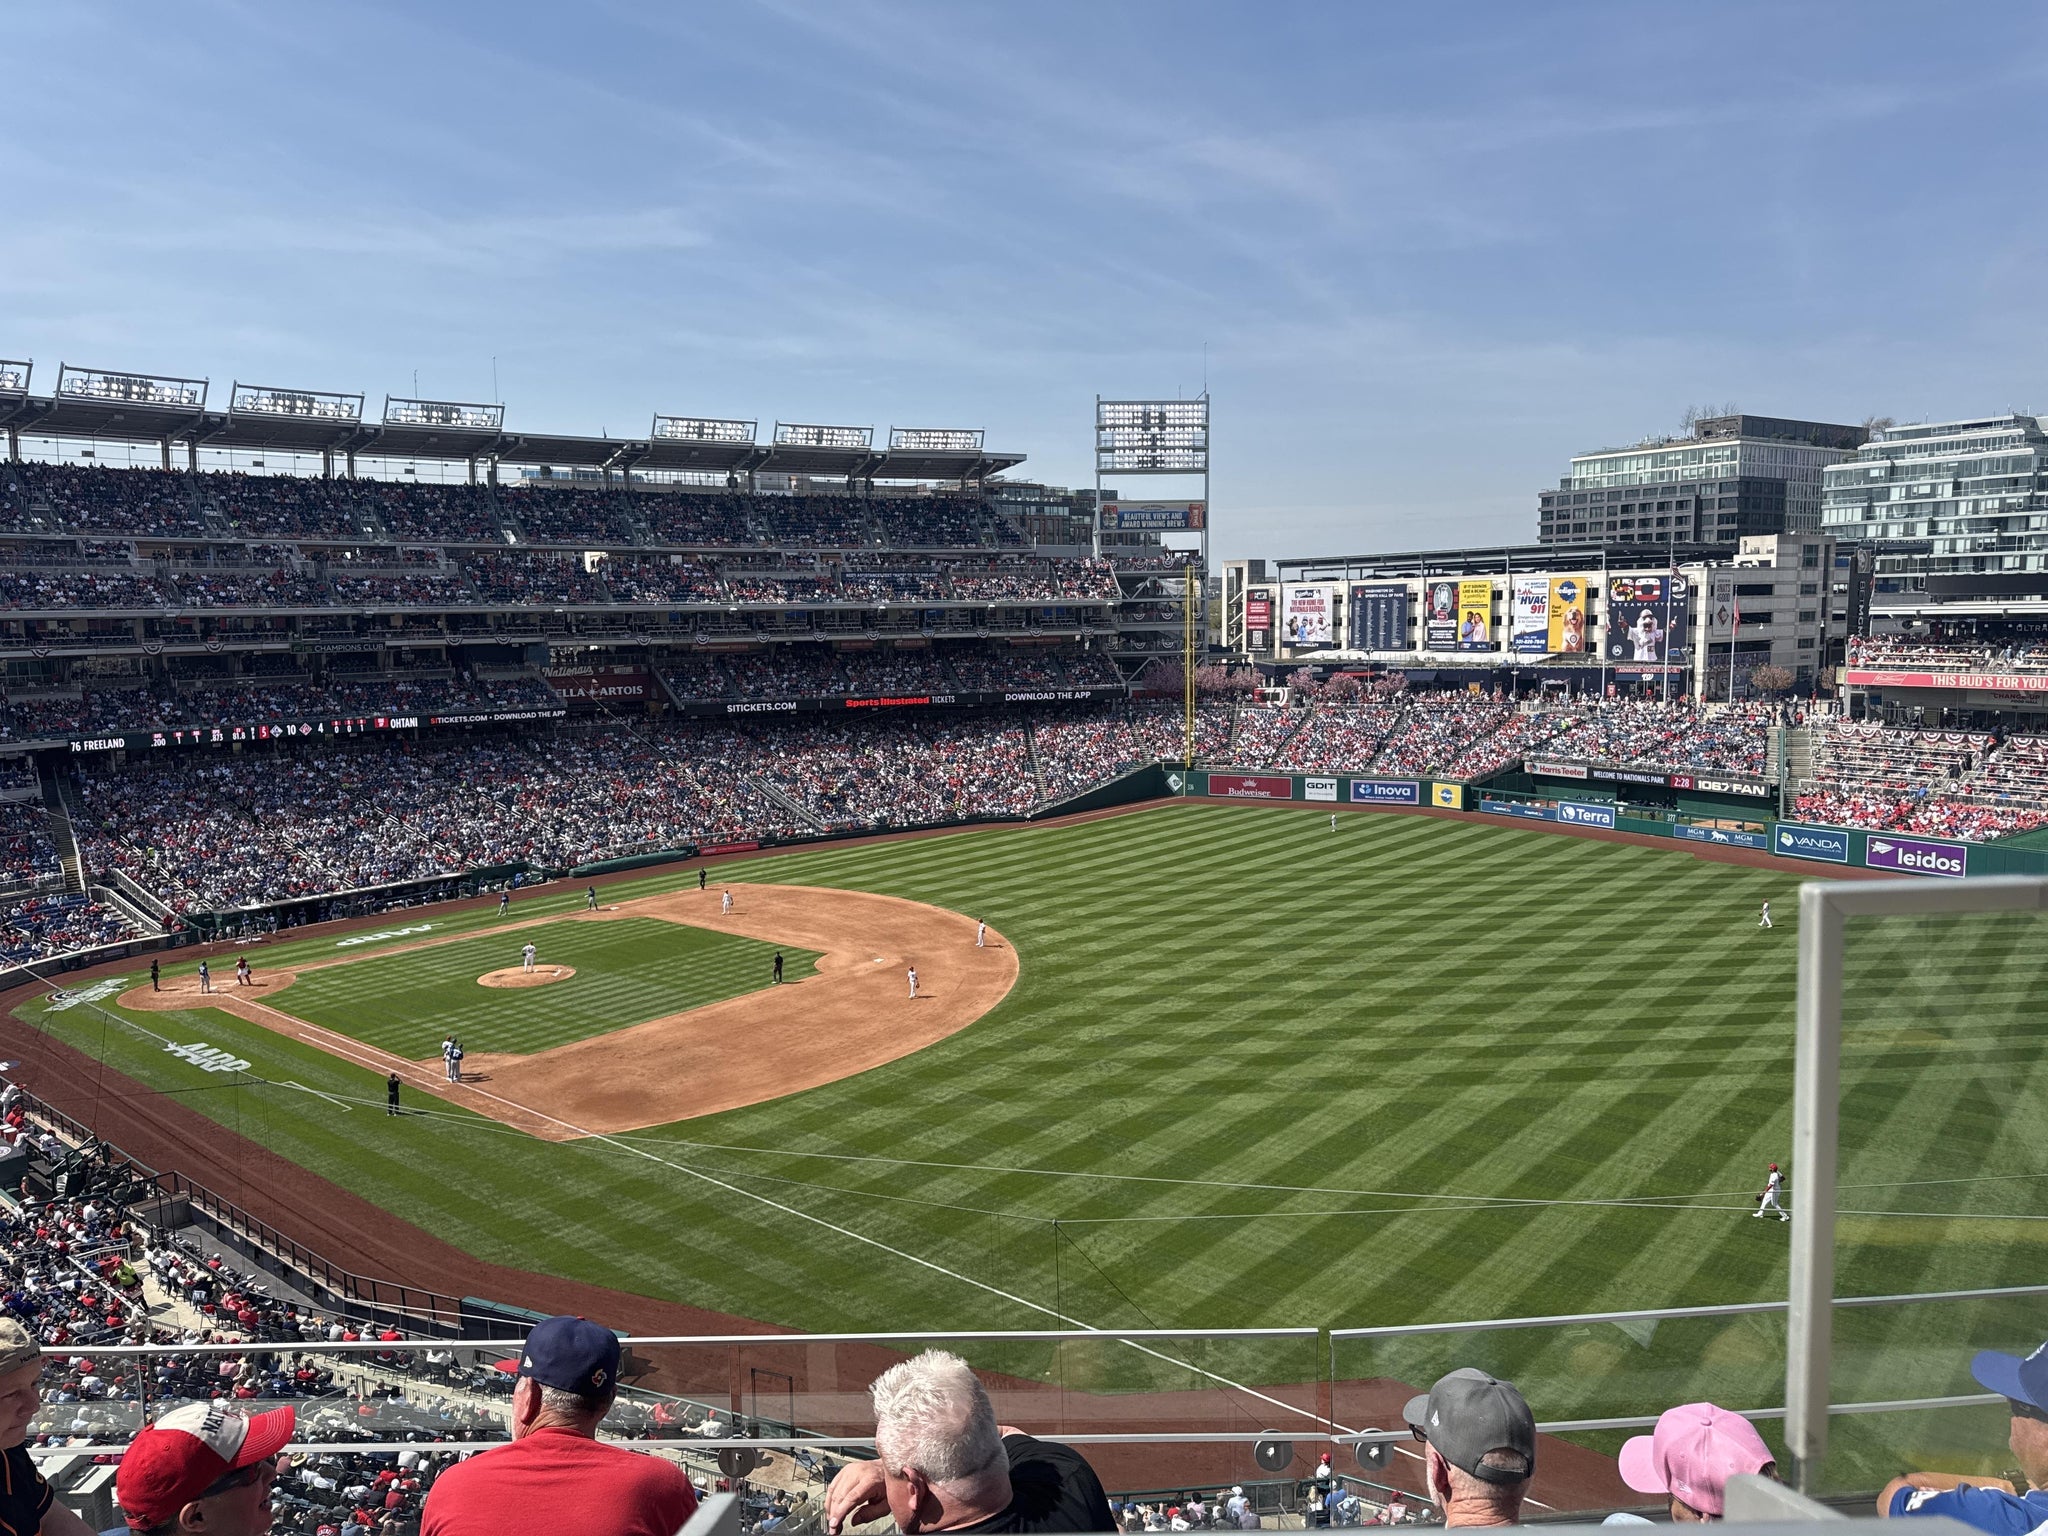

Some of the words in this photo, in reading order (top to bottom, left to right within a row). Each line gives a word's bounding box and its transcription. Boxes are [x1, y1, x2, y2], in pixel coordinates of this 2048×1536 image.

[1124, 512, 1151, 521] BEAUTIFUL
[1153, 512, 1170, 521] VIEWS
[1171, 512, 1183, 520] AND
[1121, 520, 1140, 528] AWARD
[1141, 519, 1166, 528] WINNING
[1167, 519, 1186, 528] BREWS
[1520, 596, 1547, 605] HVAC
[1530, 605, 1546, 614] 911
[314, 644, 361, 652] CHAMPIONS
[363, 643, 384, 651] CLUB
[1931, 675, 1956, 686] THIS
[1959, 676, 1993, 688] BUD'S
[1996, 677, 2018, 688] FOR
[600, 686, 643, 697] ARTOIS
[1005, 692, 1055, 701] DOWNLOAD
[1057, 692, 1072, 700] THE
[1074, 691, 1091, 699] APP
[727, 702, 797, 713] SITICKETS.COM
[846, 699, 879, 708] Sports
[880, 696, 930, 706] Illustrated
[932, 695, 956, 704] TICKETS
[391, 717, 418, 729] OHTANI
[431, 715, 487, 725] SITICKETS.COM
[494, 711, 536, 721] DOWNLOAD
[538, 710, 551, 718] THE
[287, 724, 297, 735] 10
[318, 722, 324, 733] 4
[335, 725, 339, 734] 0
[347, 724, 352, 733] 0
[71, 740, 81, 752] 76
[84, 738, 125, 751] FREELAND
[151, 738, 166, 748] .200
[211, 732, 223, 742] .873
[232, 731, 246, 741] 81.8
[1539, 766, 1560, 775] Harris
[1562, 769, 1585, 778] Teeter
[1593, 771, 1615, 779] WELCOME
[1624, 773, 1650, 783] NATIONALS
[1651, 776, 1664, 784] PARK
[1306, 782, 1335, 790] GDIT
[1674, 777, 1689, 787] 2:28
[1228, 787, 1271, 797] Budweiser
[1374, 784, 1410, 796] Inova
[1733, 783, 1765, 796] FAN
[1576, 808, 1610, 823] Terra
[1667, 814, 1675, 822] 377
[1687, 828, 1704, 836] MGM
[1734, 834, 1752, 842] MGM
[1795, 836, 1842, 850] VANDA
[1897, 847, 1960, 872] leidos
[163, 1041, 252, 1073] AARP
